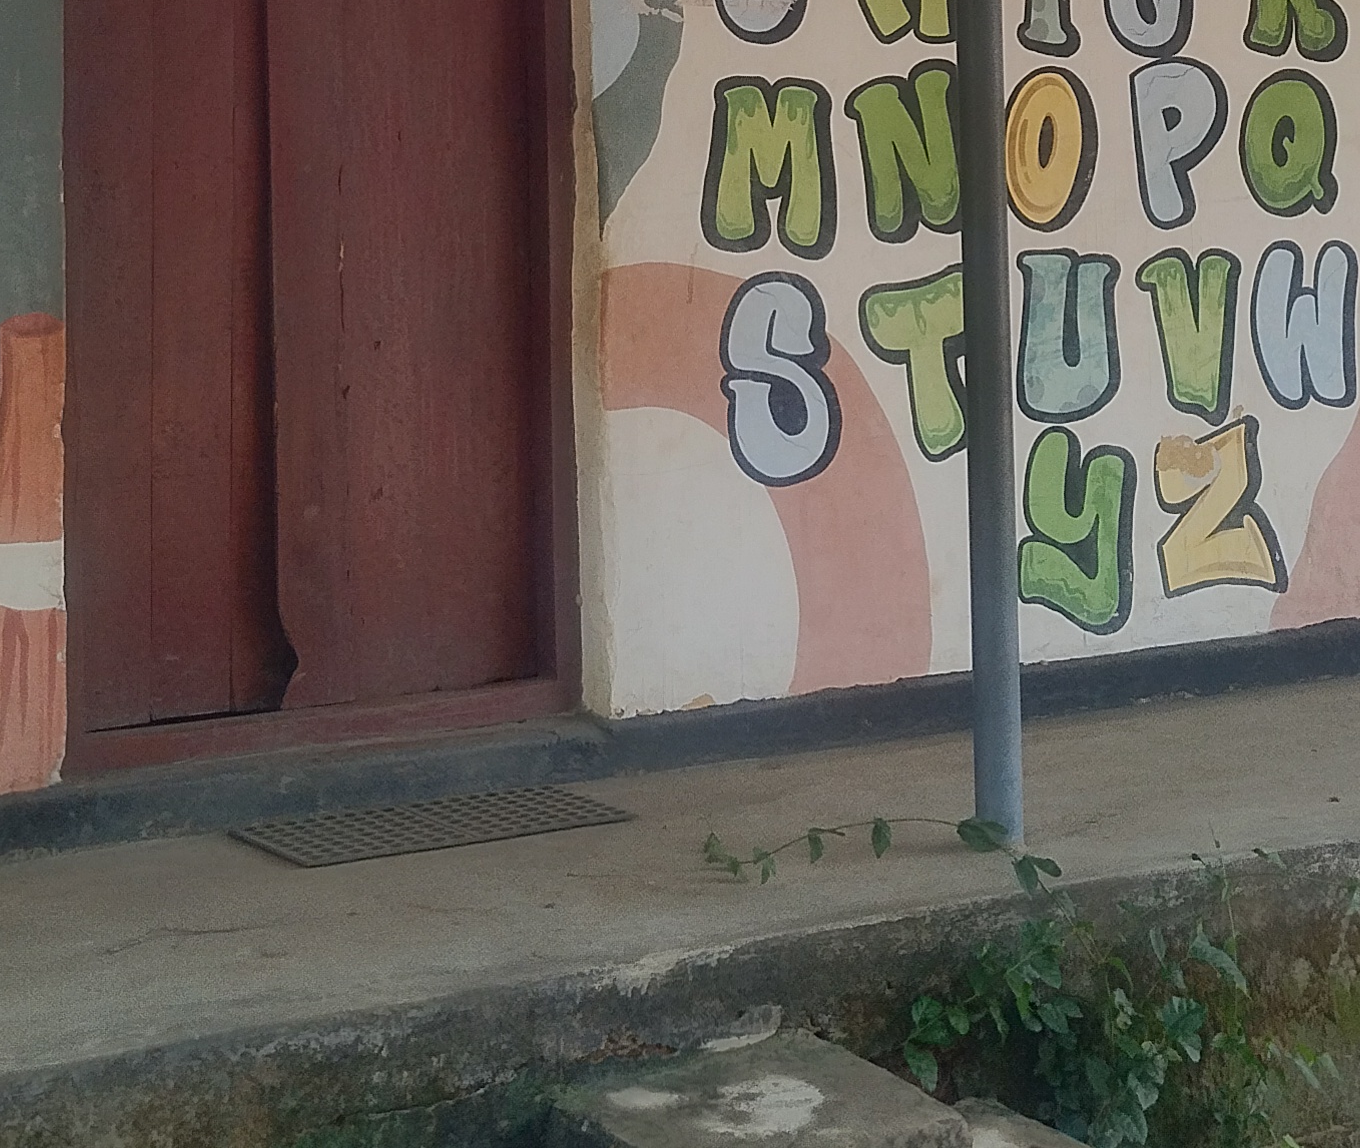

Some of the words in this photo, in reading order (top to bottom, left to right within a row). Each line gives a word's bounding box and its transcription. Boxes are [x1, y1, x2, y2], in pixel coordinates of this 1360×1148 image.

[701, 75, 835, 260] M
[844, 59, 961, 243] N
[1004, 65, 1097, 230] O
[1129, 56, 1229, 230] P
[1240, 68, 1340, 220] Q
[720, 271, 841, 487] S
[859, 262, 967, 462] T
[1016, 248, 1121, 422] U
[1136, 248, 1241, 424] V
[1250, 239, 1359, 409] W
[1018, 425, 1136, 635] Y
[1155, 415, 1288, 599] Z
